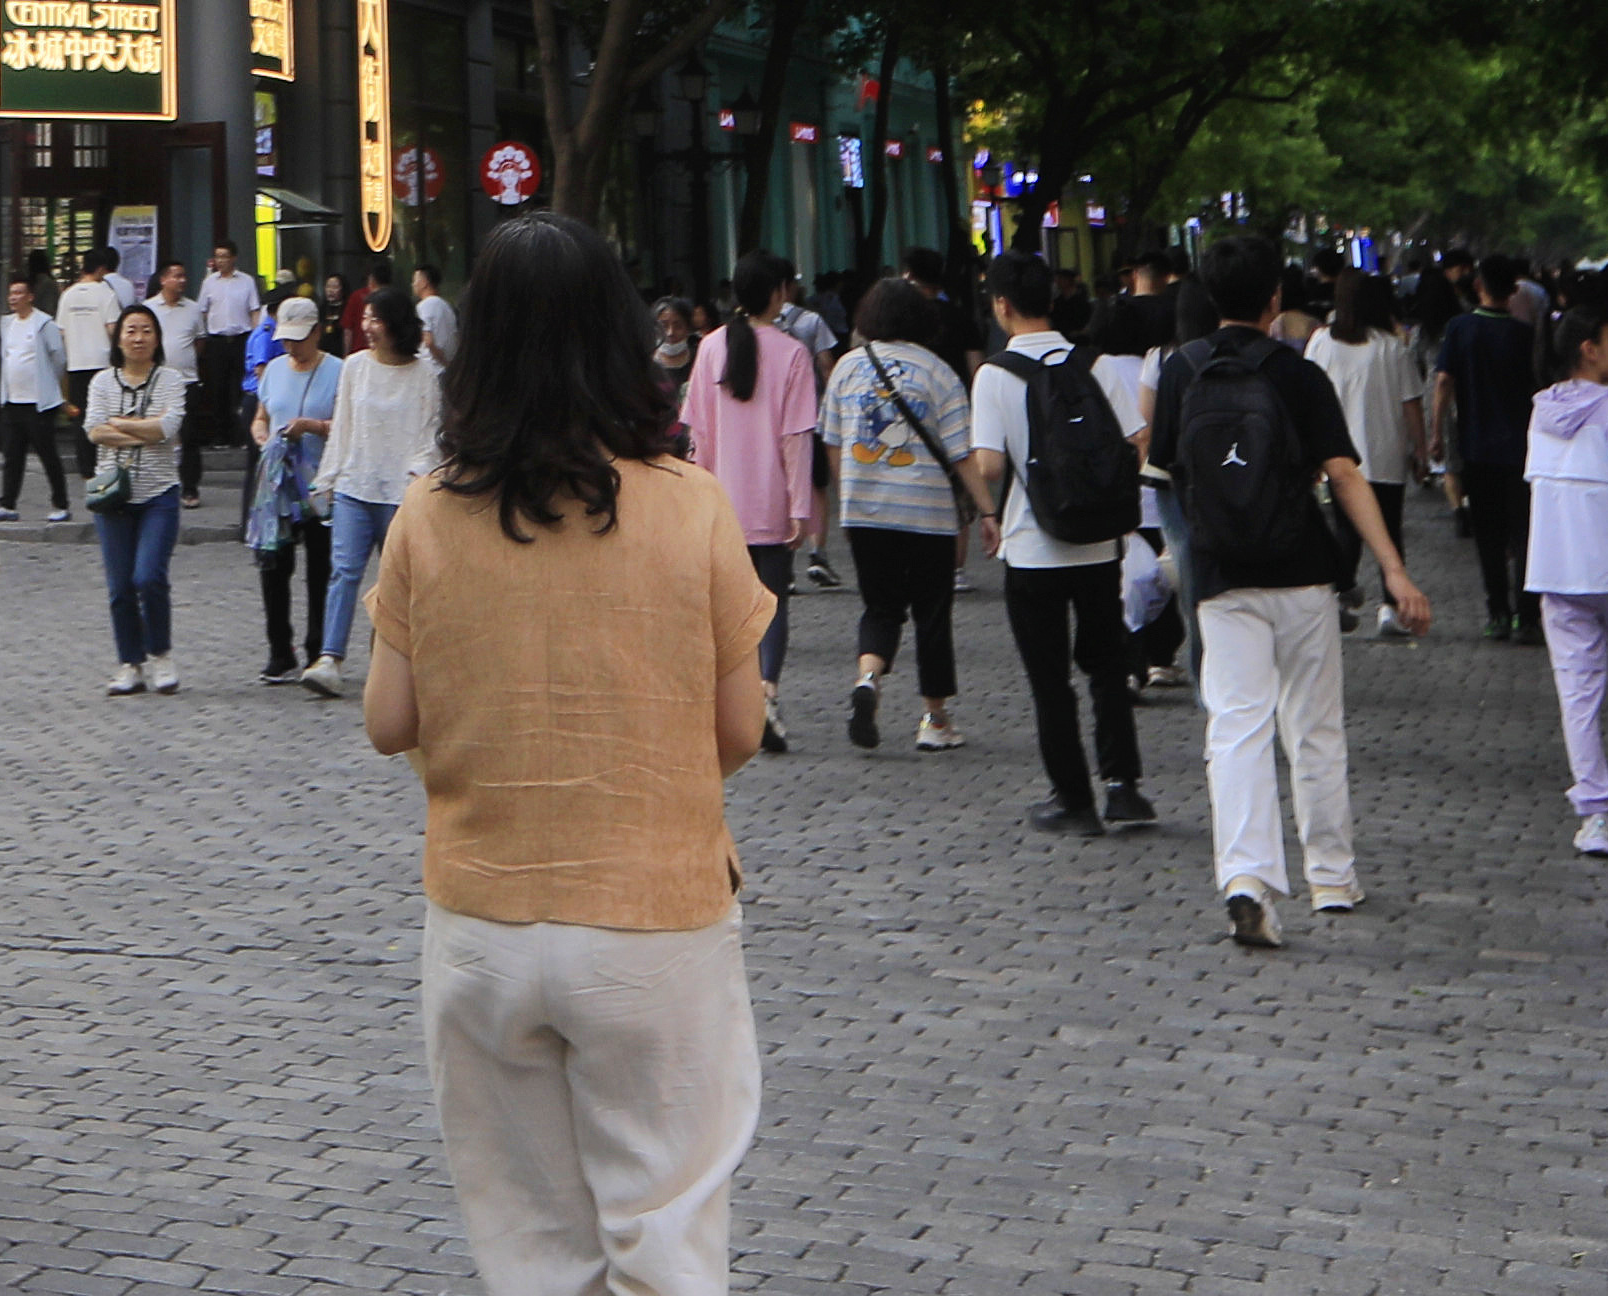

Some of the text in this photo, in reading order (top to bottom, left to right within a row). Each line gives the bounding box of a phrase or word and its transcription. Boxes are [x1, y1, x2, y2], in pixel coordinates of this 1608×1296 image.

[92, 2, 160, 32] STREET
[1, 29, 162, 74] 冰城中央大街
